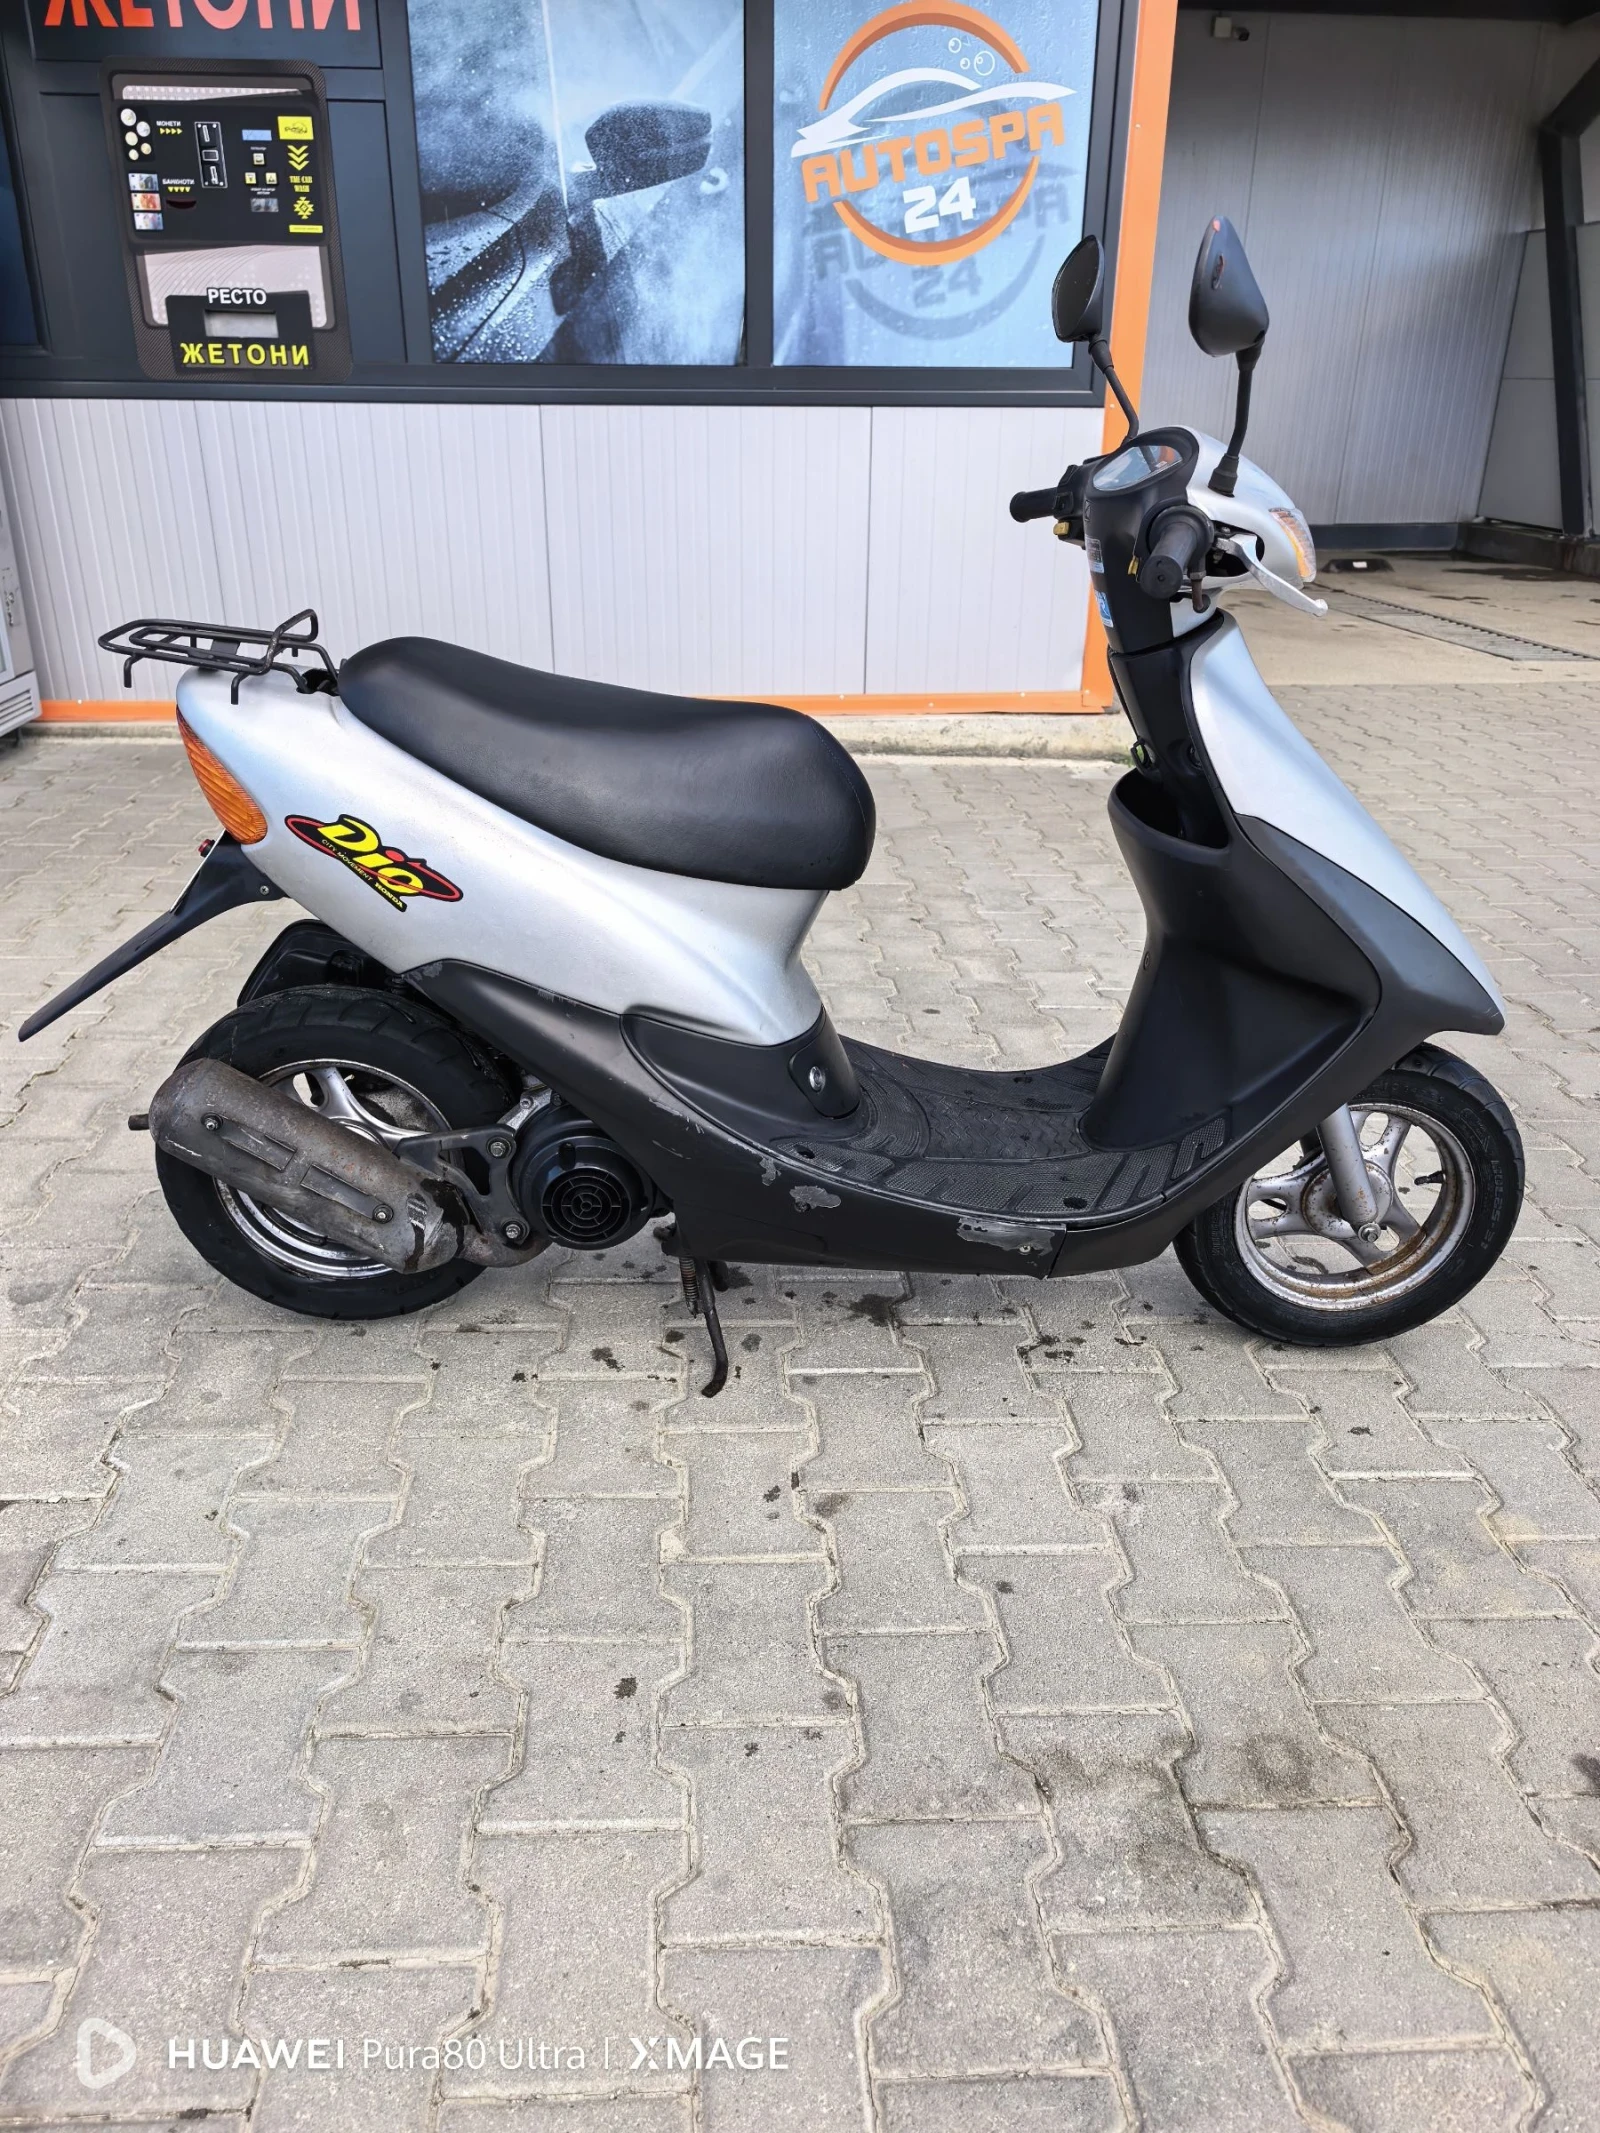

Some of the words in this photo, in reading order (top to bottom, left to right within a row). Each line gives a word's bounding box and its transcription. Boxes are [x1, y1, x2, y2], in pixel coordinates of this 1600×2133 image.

[801, 102, 1065, 203] AUTOSPA
[902, 176, 977, 234] 24
[207, 288, 267, 305] РЕСТО
[180, 343, 309, 366] ЖЕТОНИ
[317, 817, 424, 894] Dio
[321, 839, 338, 852] CITY
[337, 851, 373, 881] MOVEMENT
[374, 882, 403, 908] HONDA
